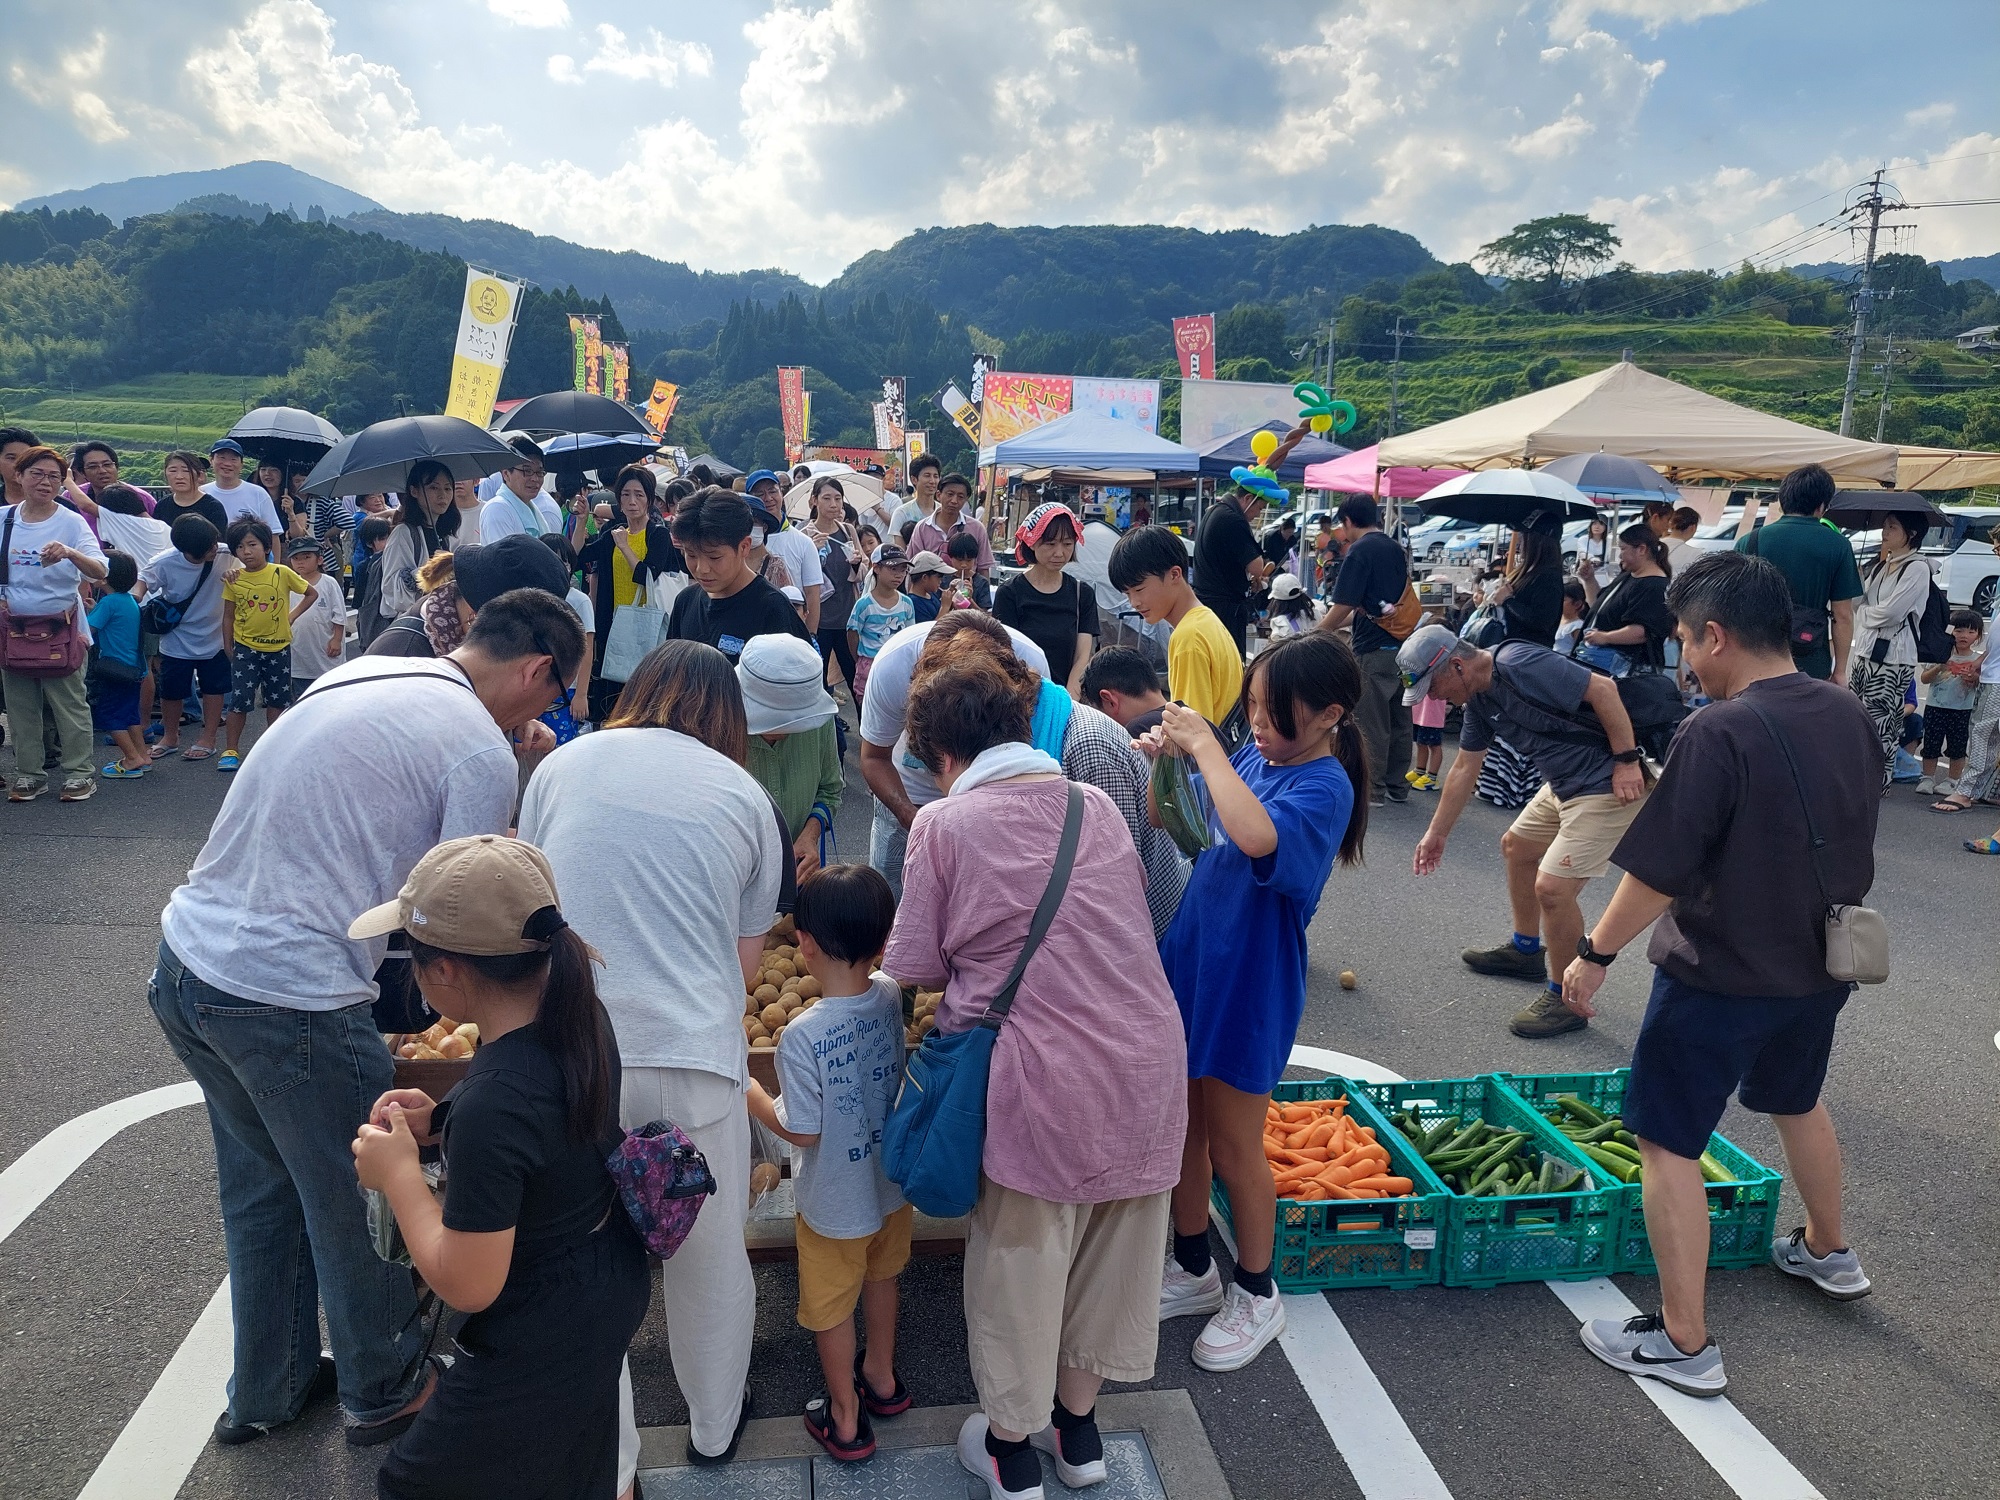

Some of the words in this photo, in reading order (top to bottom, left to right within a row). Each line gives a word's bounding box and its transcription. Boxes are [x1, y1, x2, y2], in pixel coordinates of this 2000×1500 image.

[813, 1031, 855, 1059] Home
[855, 1018, 881, 1040] Run
[825, 1023, 846, 1038] Make
[827, 1046, 859, 1073] PLAY
[828, 1075, 853, 1087] BALL
[872, 1061, 898, 1082] SEE
